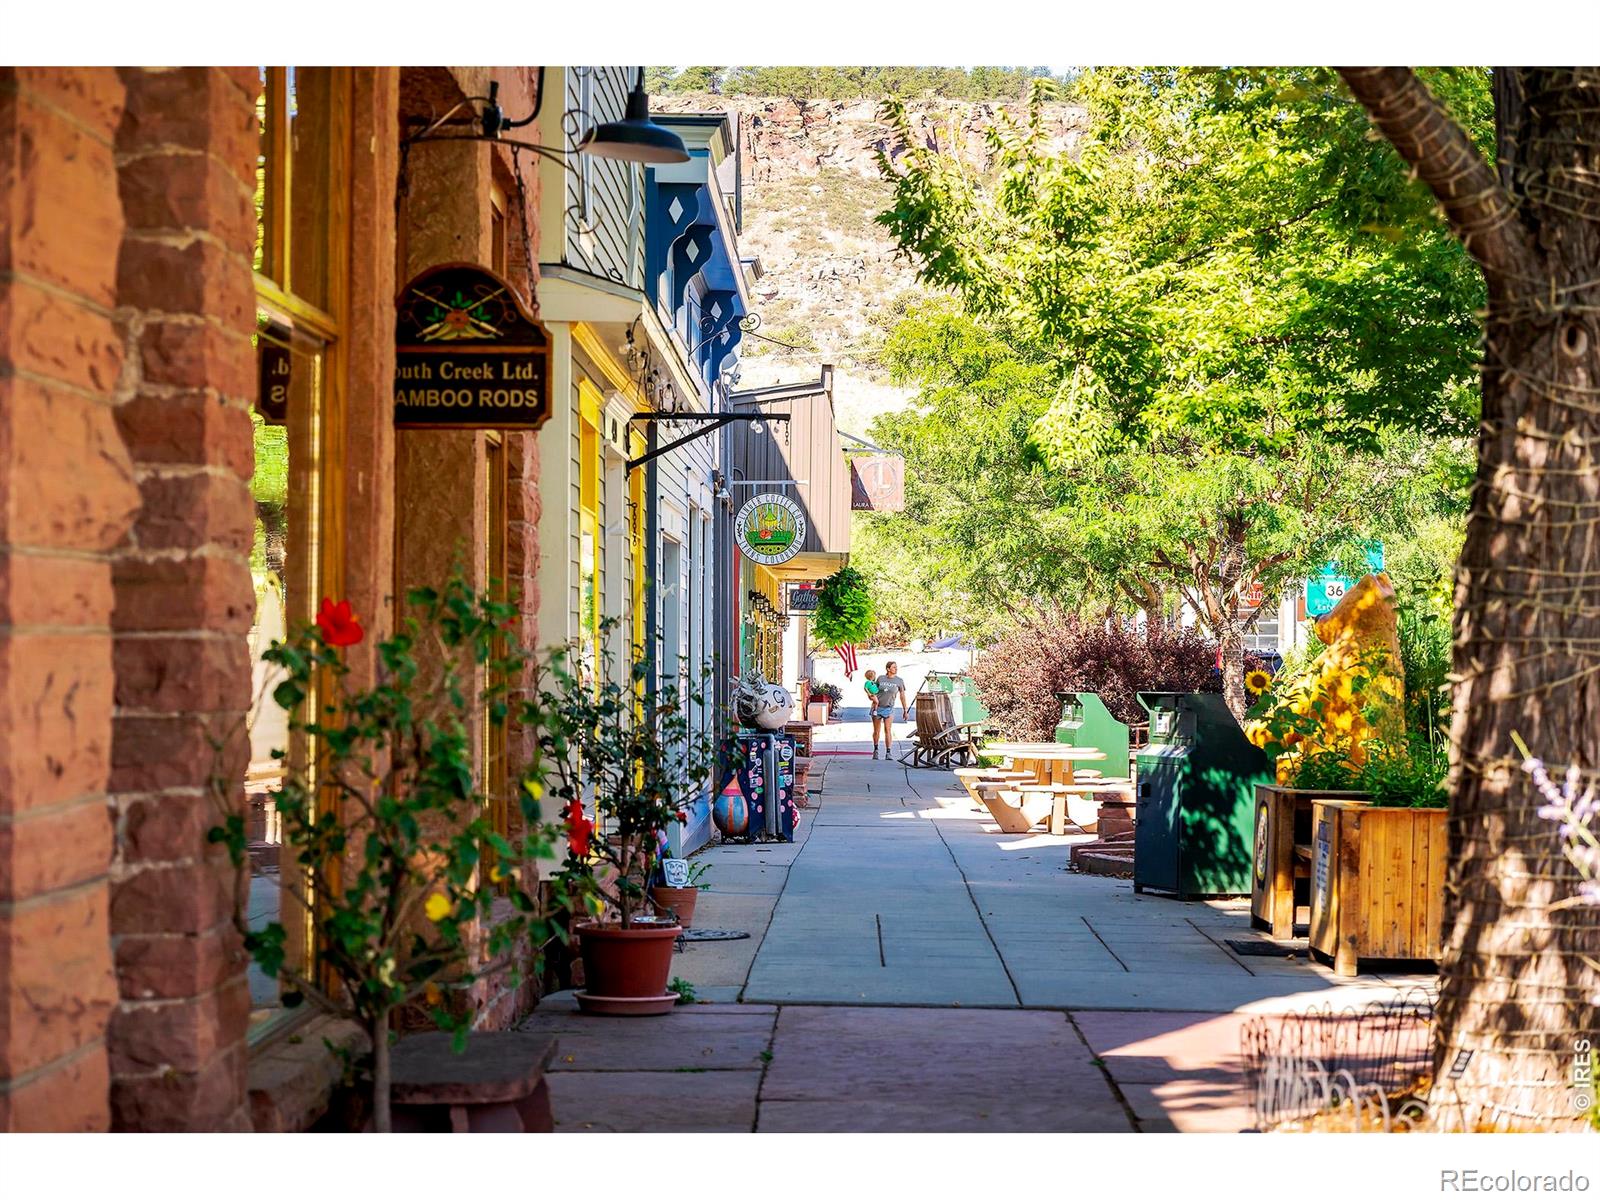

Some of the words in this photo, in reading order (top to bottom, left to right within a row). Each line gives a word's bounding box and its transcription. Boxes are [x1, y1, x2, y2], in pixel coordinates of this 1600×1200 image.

[395, 362, 432, 380] outh
[439, 362, 494, 380] Creek
[502, 361, 538, 380] Ltd.
[395, 389, 473, 407] AMBOO
[478, 389, 538, 408] RODS
[765, 494, 793, 510] COFFEE
[739, 540, 761, 561] LYONS
[765, 539, 802, 564] COLORADO
[1327, 585, 1344, 597] 36
